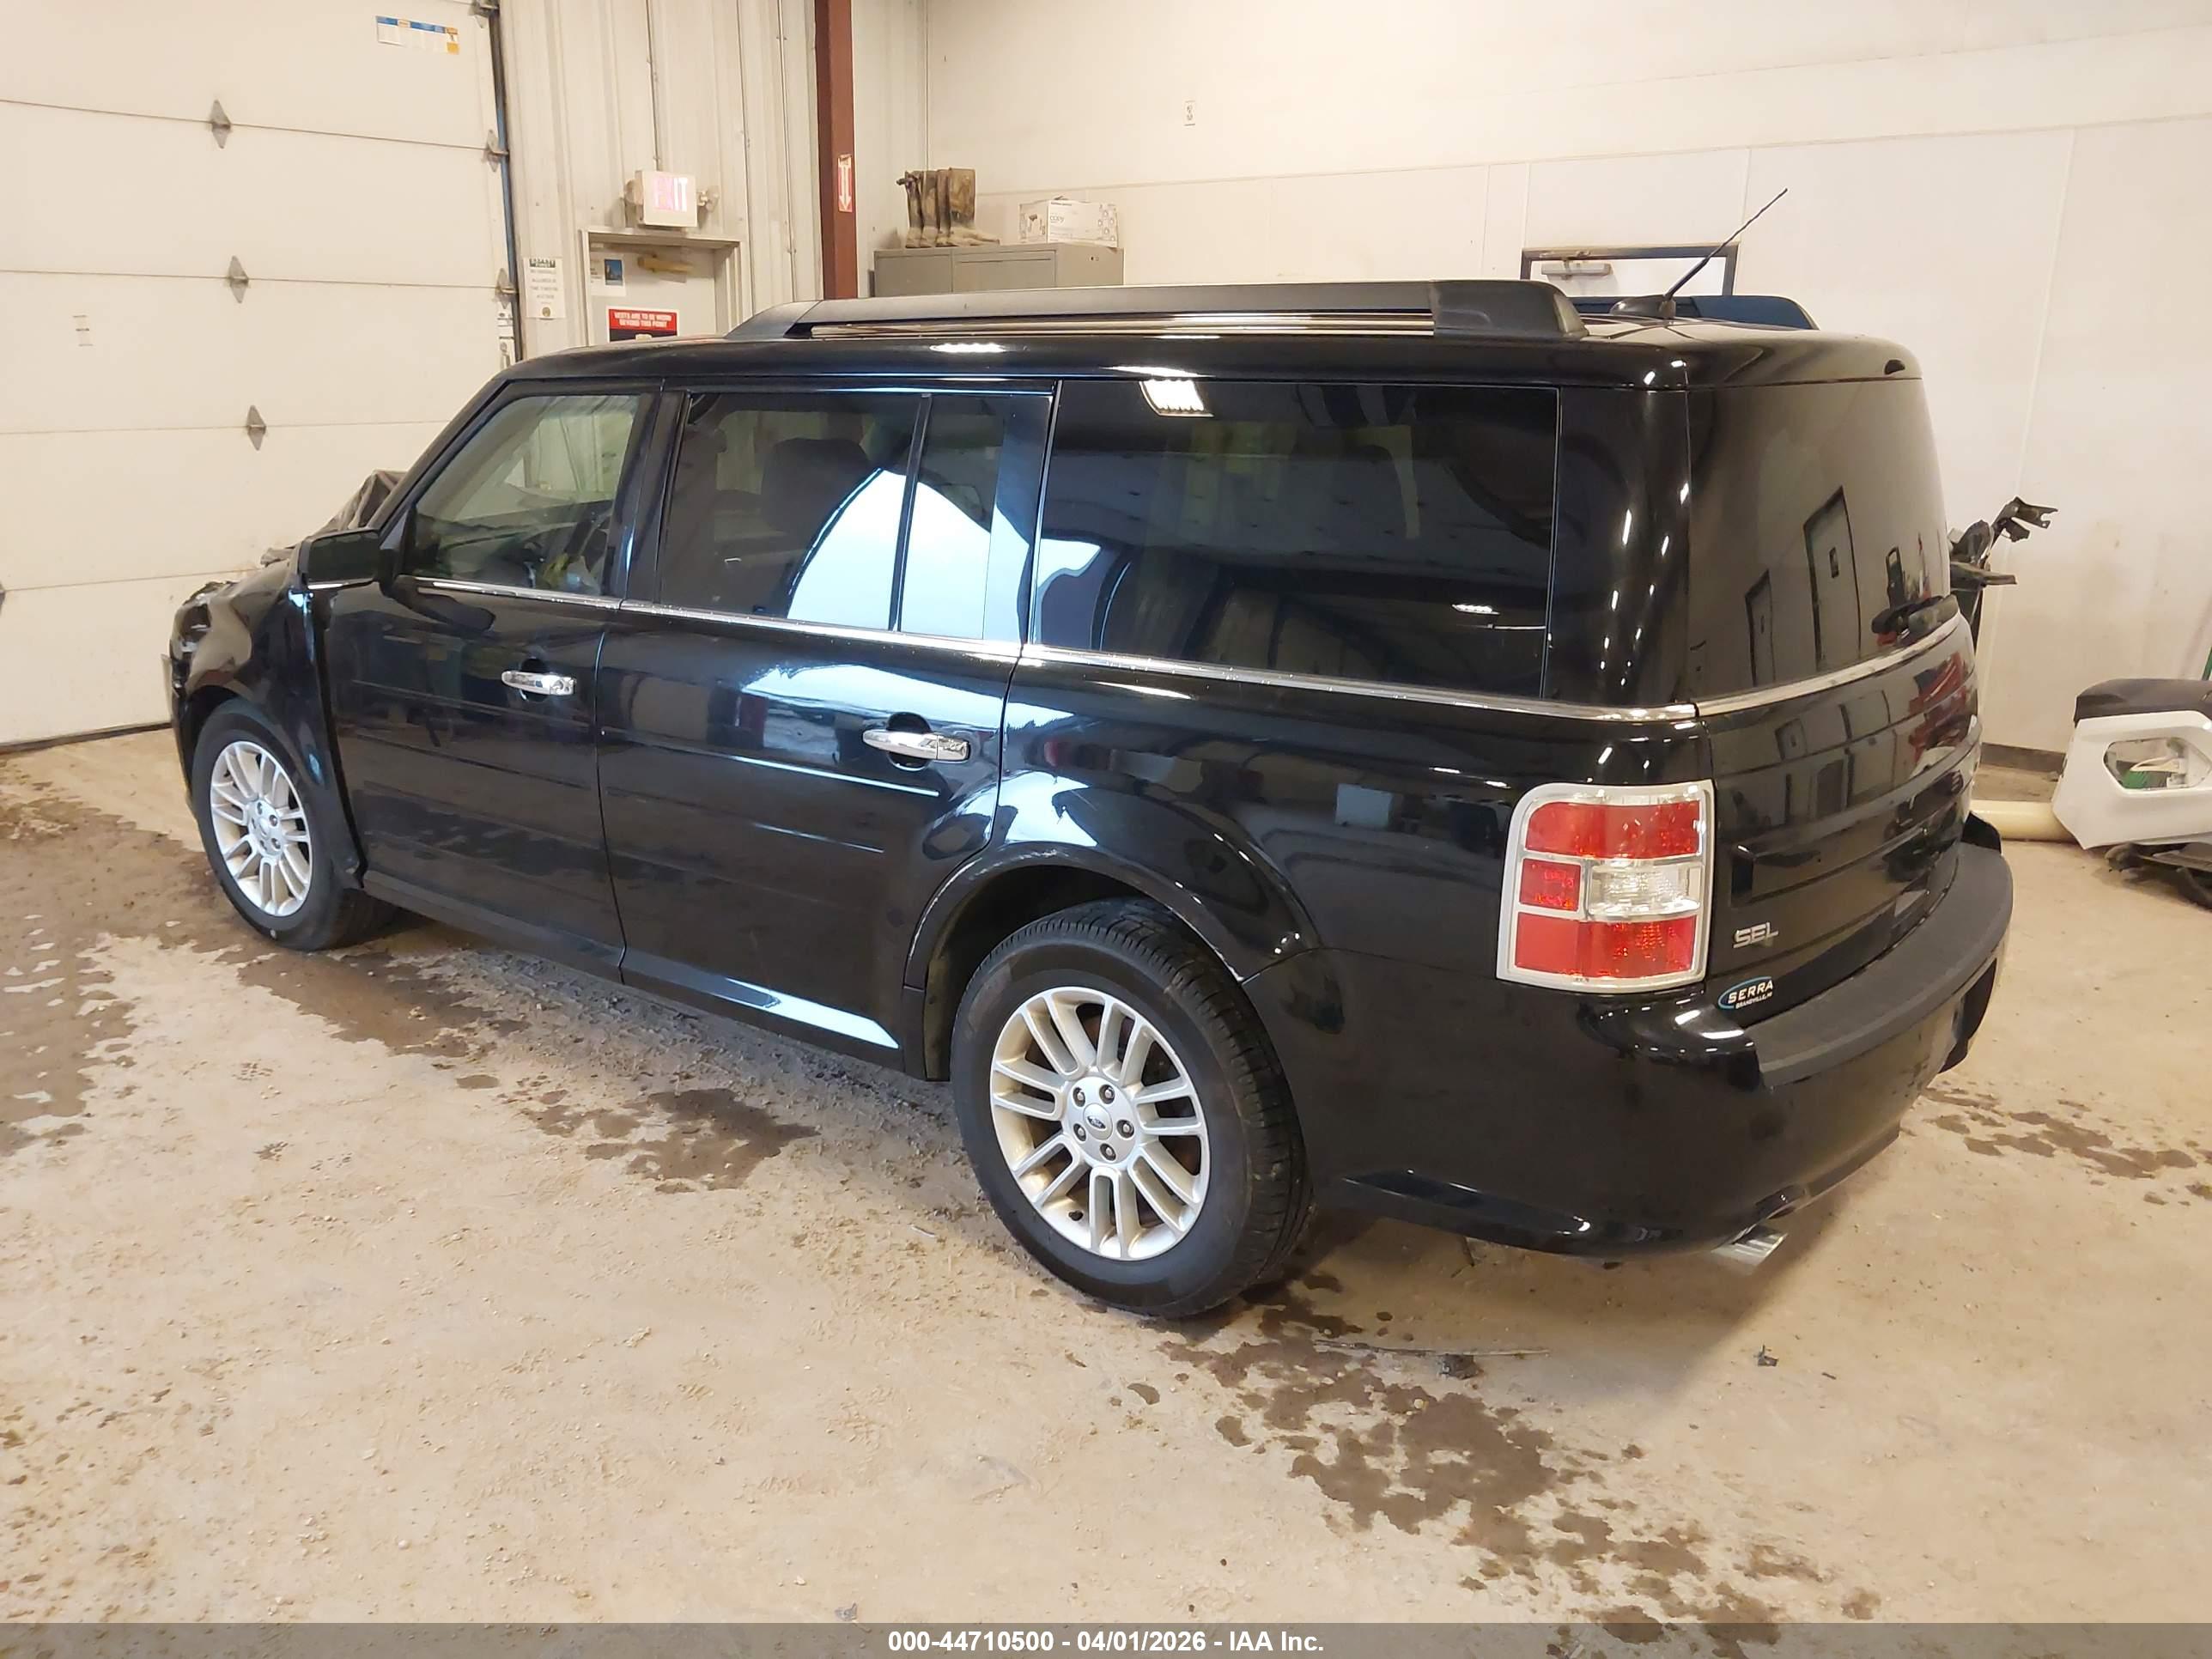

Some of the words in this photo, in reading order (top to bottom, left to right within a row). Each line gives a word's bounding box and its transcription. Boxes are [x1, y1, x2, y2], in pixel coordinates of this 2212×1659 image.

[653, 177, 688, 212] EXIT
[1733, 921, 1778, 949] SEL
[1728, 980, 1773, 1004] SERRA
